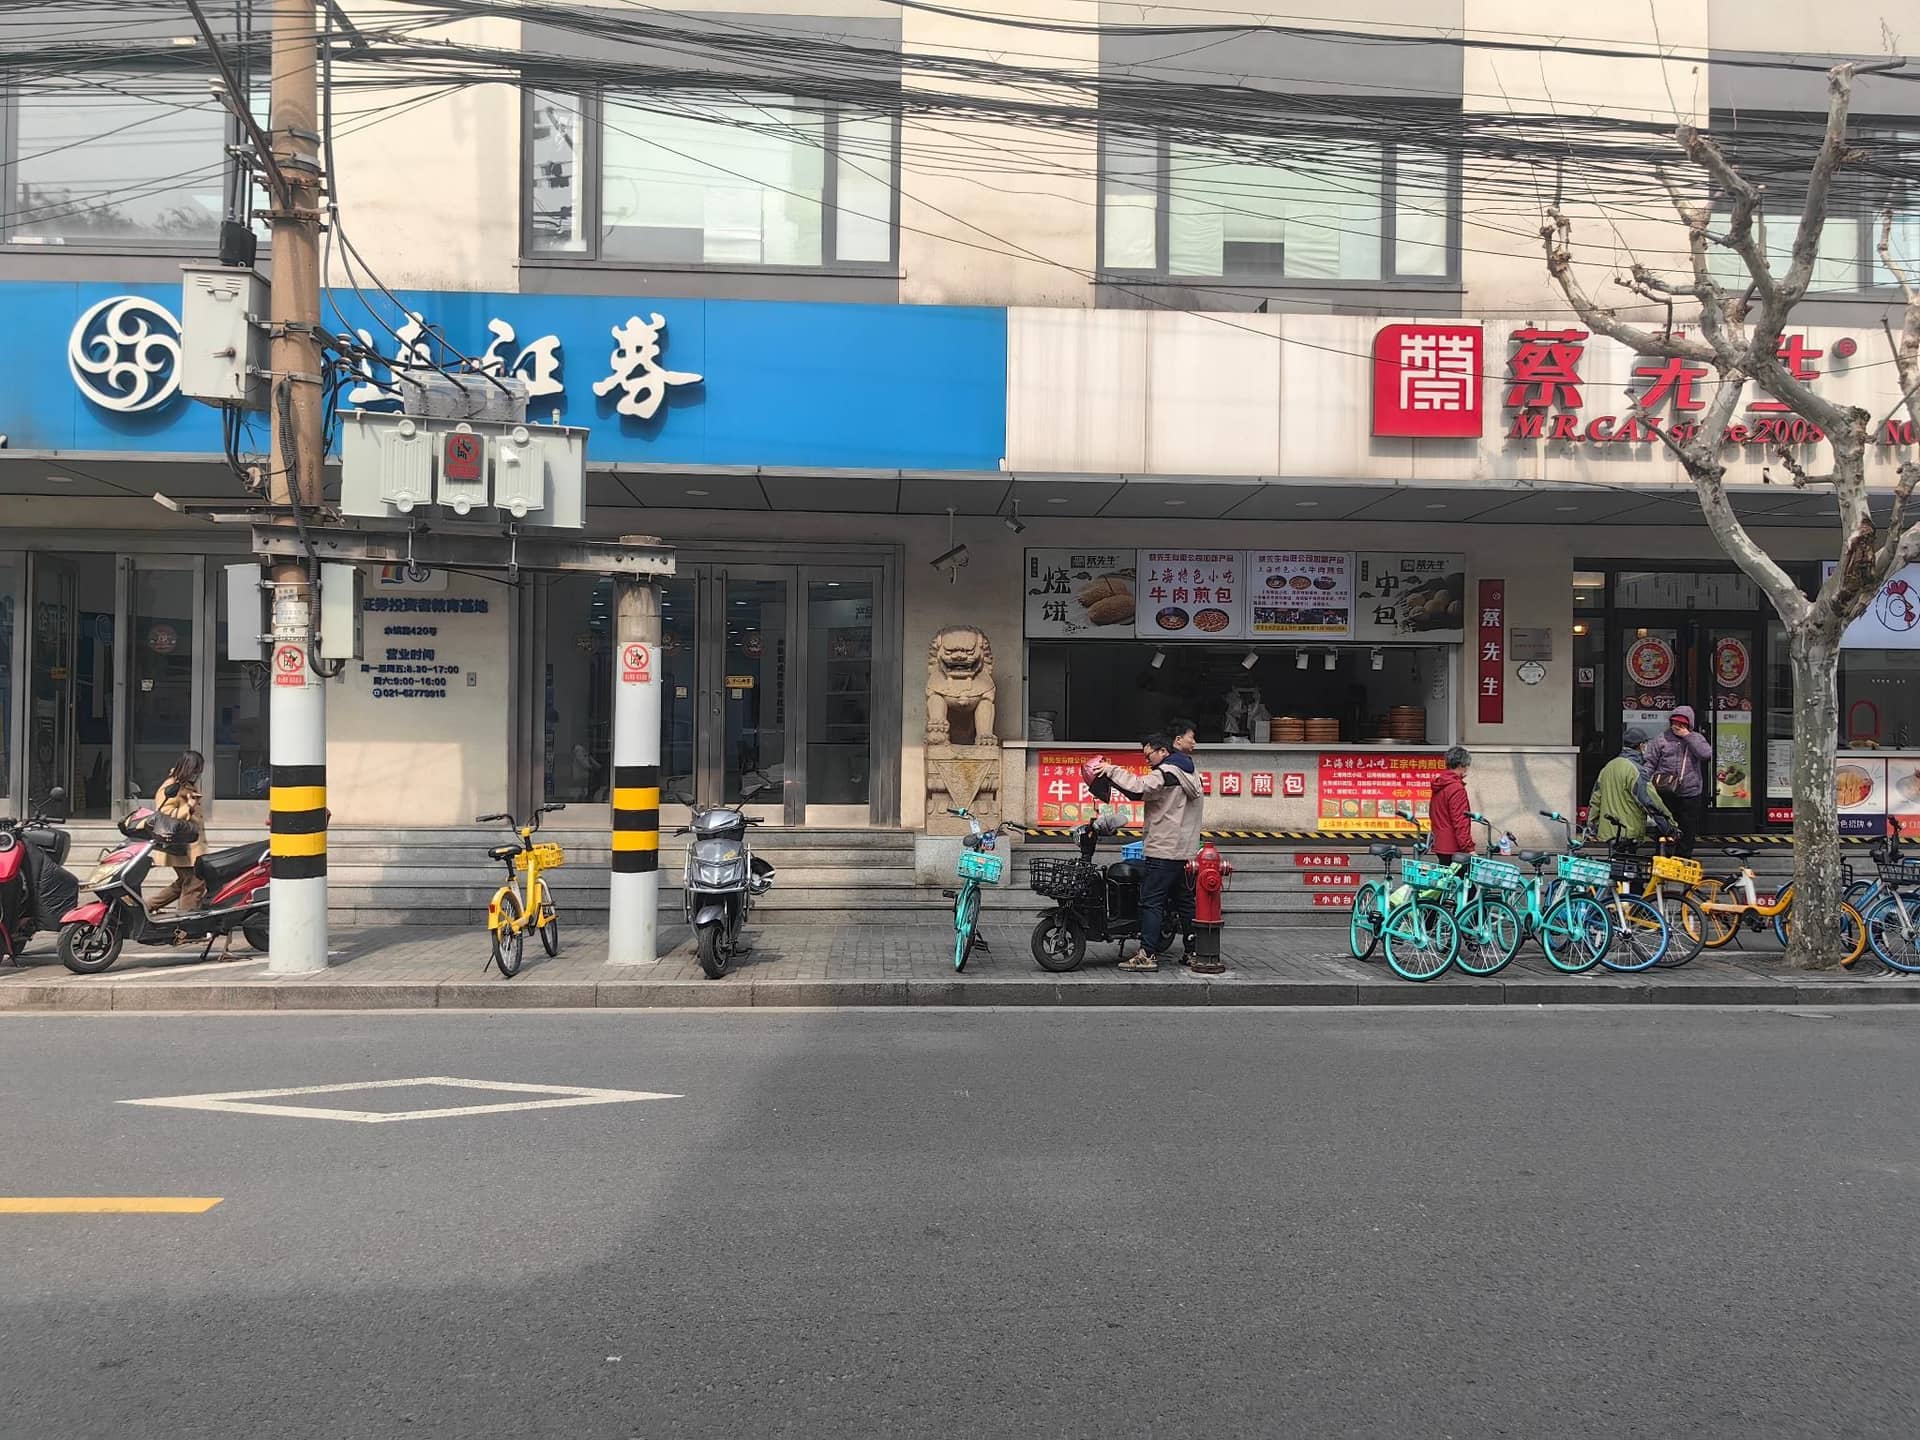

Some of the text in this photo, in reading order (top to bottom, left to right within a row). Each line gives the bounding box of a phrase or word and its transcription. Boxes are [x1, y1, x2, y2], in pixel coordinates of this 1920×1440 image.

[1148, 568, 1235, 584] 上海特色小吃
[1042, 566, 1072, 622] 烧饼
[1149, 586, 1233, 604] 牛肉煎包
[386, 648, 435, 661] 营业时间
[1481, 608, 1501, 696] 蔡先生
[1323, 759, 1388, 769] 上海特色小吃
[1302, 856, 1342, 865] 小心台阶
[1312, 874, 1352, 884] 小心台阶
